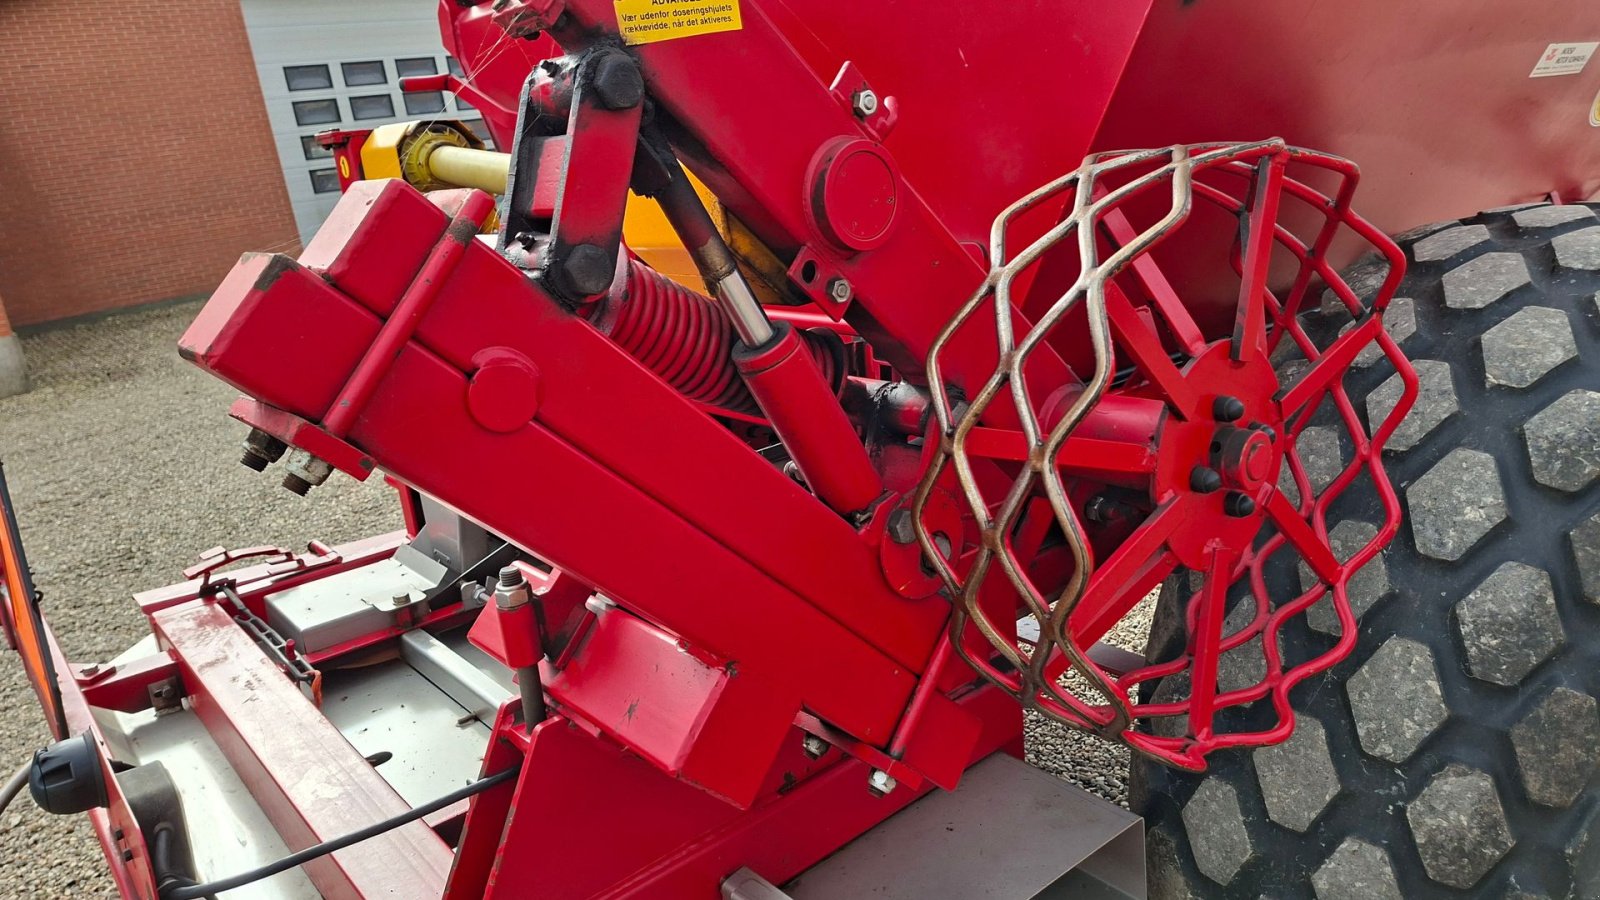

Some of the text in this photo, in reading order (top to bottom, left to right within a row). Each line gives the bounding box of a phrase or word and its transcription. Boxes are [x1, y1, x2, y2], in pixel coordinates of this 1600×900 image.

[622, 4, 732, 22] Vær udenfor doseringshjulets
[624, 15, 734, 34] rækkevidde, når det aktiveres.
